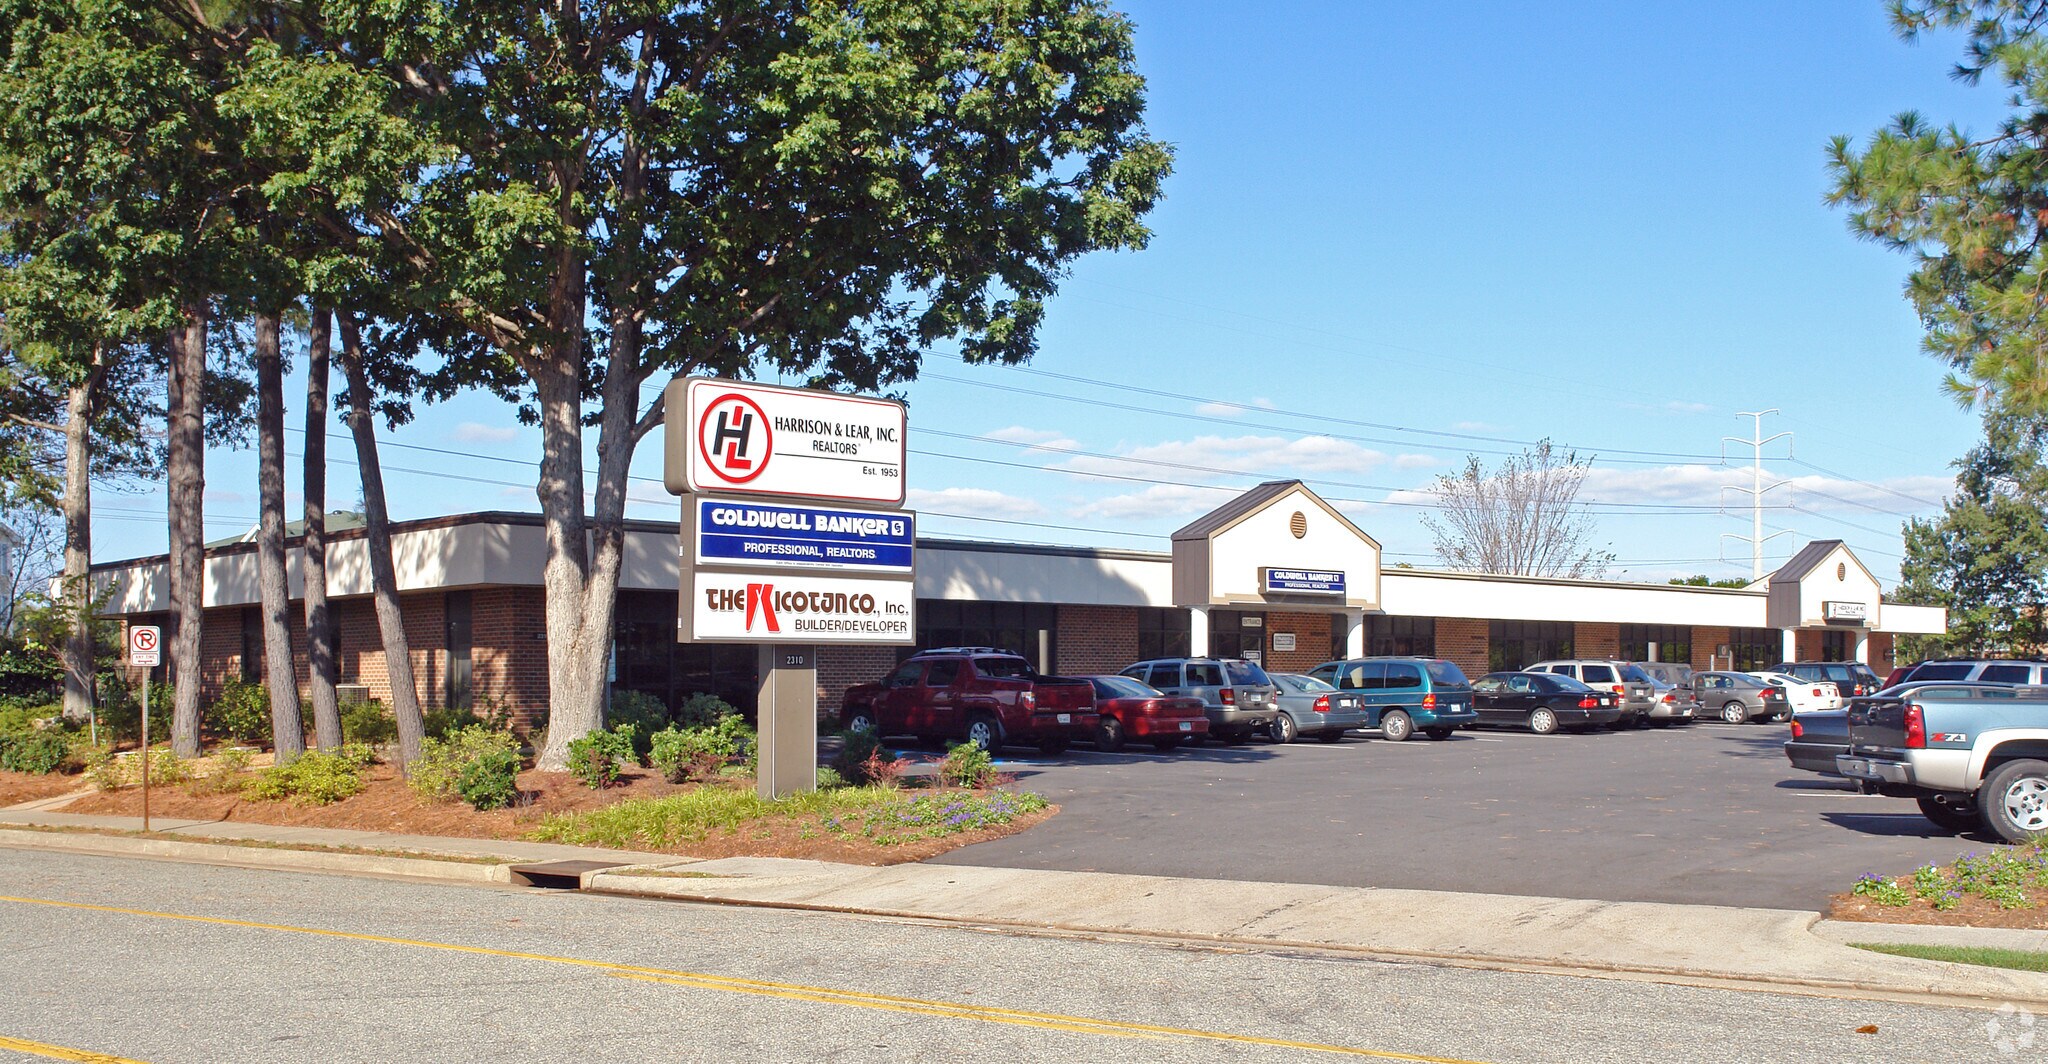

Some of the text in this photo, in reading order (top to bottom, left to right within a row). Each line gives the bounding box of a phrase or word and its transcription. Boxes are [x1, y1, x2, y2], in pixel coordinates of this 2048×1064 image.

[775, 417, 898, 444] HARRISON & LEAR, INC.
[812, 440, 858, 455] REALTORS
[862, 466, 899, 477] Est. 1953
[712, 508, 811, 530] COLDWELL
[815, 515, 889, 537] BANKER
[744, 542, 876, 559] PROFESSIONAL, REALTORS
[706, 589, 745, 611] THE
[885, 601, 909, 615] Inc.
[795, 619, 907, 632] BUILDER/DEVELOPER
[786, 655, 804, 665] 2310
[1930, 732, 1967, 742] Z71
